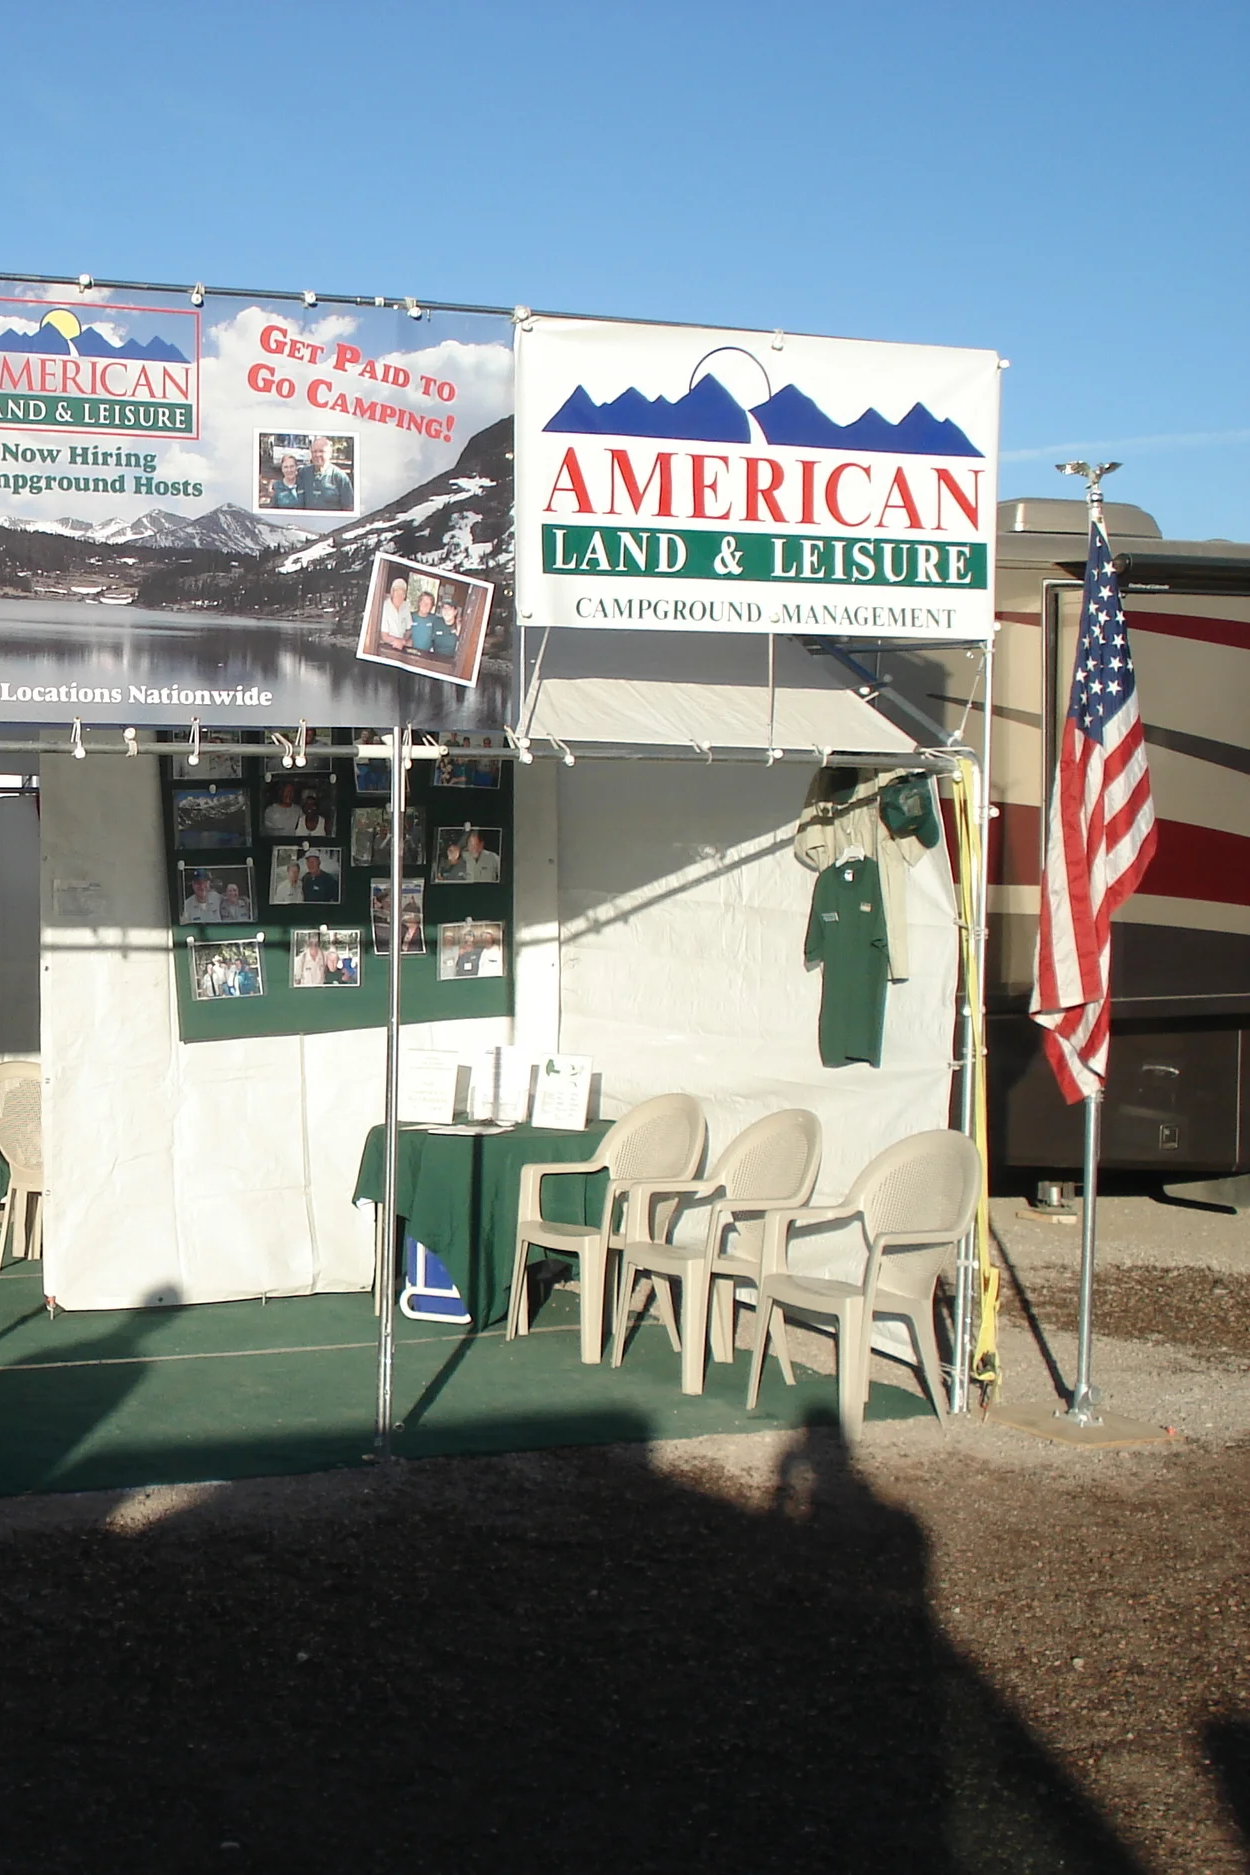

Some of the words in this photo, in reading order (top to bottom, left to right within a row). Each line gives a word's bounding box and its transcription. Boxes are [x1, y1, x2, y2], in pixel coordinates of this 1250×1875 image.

[55, 401, 74, 423] &
[84, 403, 186, 428] LEISURE
[1, 443, 61, 464] Now
[68, 445, 157, 473] Hiring
[133, 475, 203, 497] Hosts
[542, 447, 985, 531] AMERICAN
[553, 529, 687, 573] LAND
[713, 535, 744, 575] &
[771, 538, 972, 584] LEISURE
[576, 597, 762, 623] CAMPGROUND
[782, 603, 956, 629] MANAGEMENT
[0, 680, 122, 704] Locations
[128, 683, 273, 706] Nationwide
